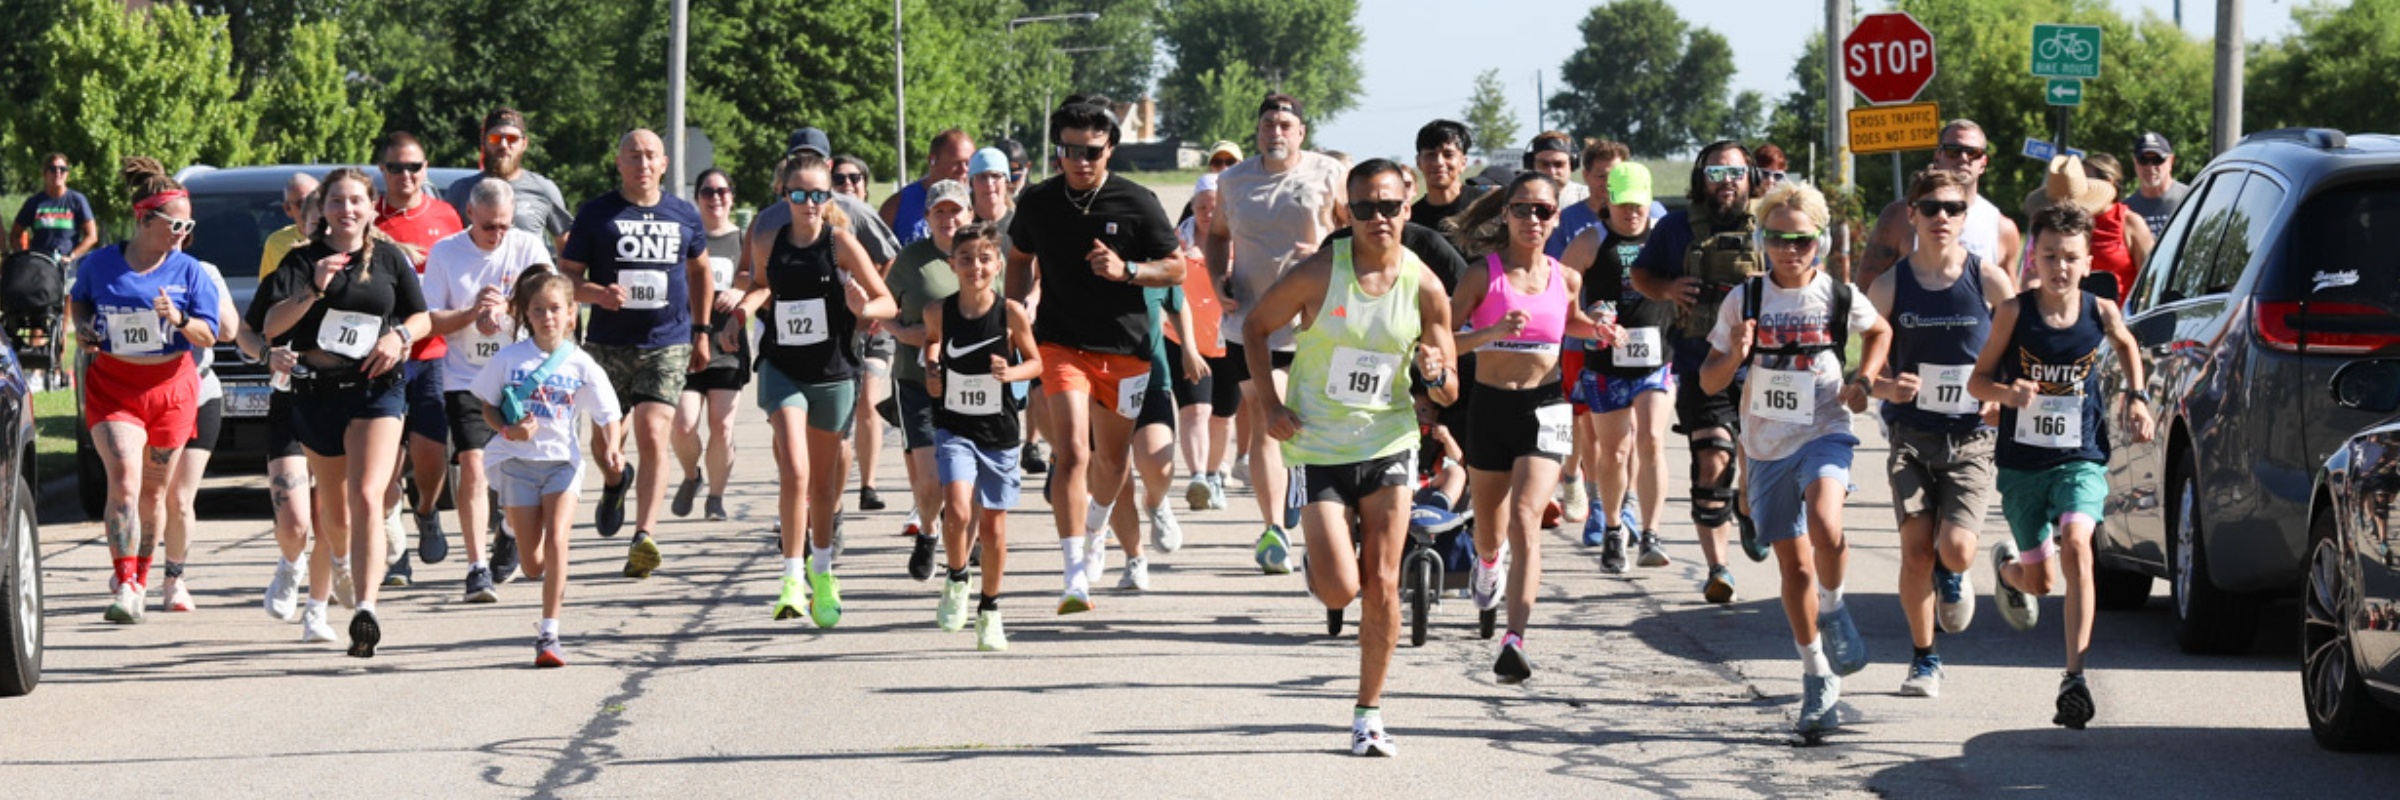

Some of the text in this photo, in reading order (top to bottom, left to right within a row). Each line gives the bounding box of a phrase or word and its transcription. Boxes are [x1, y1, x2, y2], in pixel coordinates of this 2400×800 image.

[1849, 41, 1928, 77] STOP
[2035, 62, 2094, 75] BIKE ROUTE
[1854, 110, 1931, 128] CROSS TRAFFIC
[1854, 127, 1937, 145] DOES NOT STOP
[615, 220, 681, 236] WE ARE
[616, 235, 682, 260] ONE
[631, 286, 655, 301] 180
[787, 318, 813, 335] 122
[1899, 312, 1979, 330] Champion
[123, 327, 148, 344] 120
[337, 326, 358, 346] 70
[476, 342, 500, 358] 129
[1626, 343, 1650, 358] 123
[1348, 370, 1381, 394] 191
[2030, 364, 2083, 383] GWTC
[959, 390, 986, 406] 119
[1763, 389, 1798, 410] 165
[1936, 384, 1964, 403] 177
[2033, 415, 2066, 436] 166
